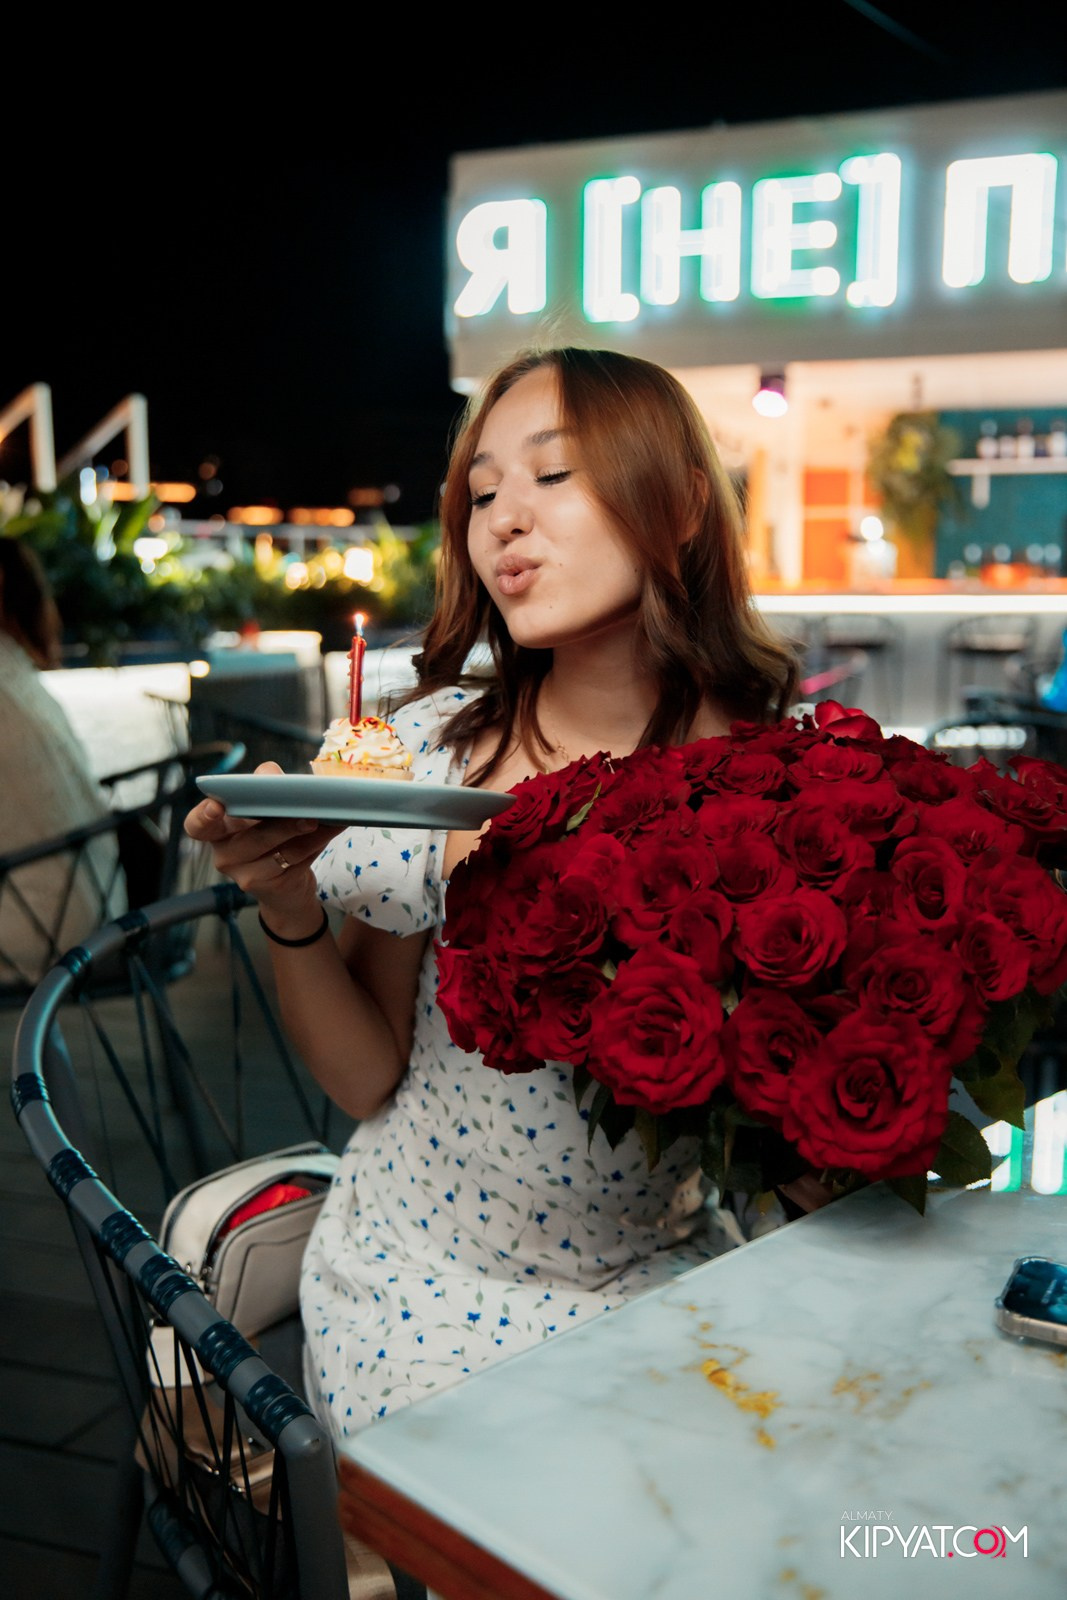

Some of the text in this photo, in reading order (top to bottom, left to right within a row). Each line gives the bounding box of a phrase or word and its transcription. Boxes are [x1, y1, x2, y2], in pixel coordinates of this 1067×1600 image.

[454, 152, 1067, 323] Я [НЕ] П
